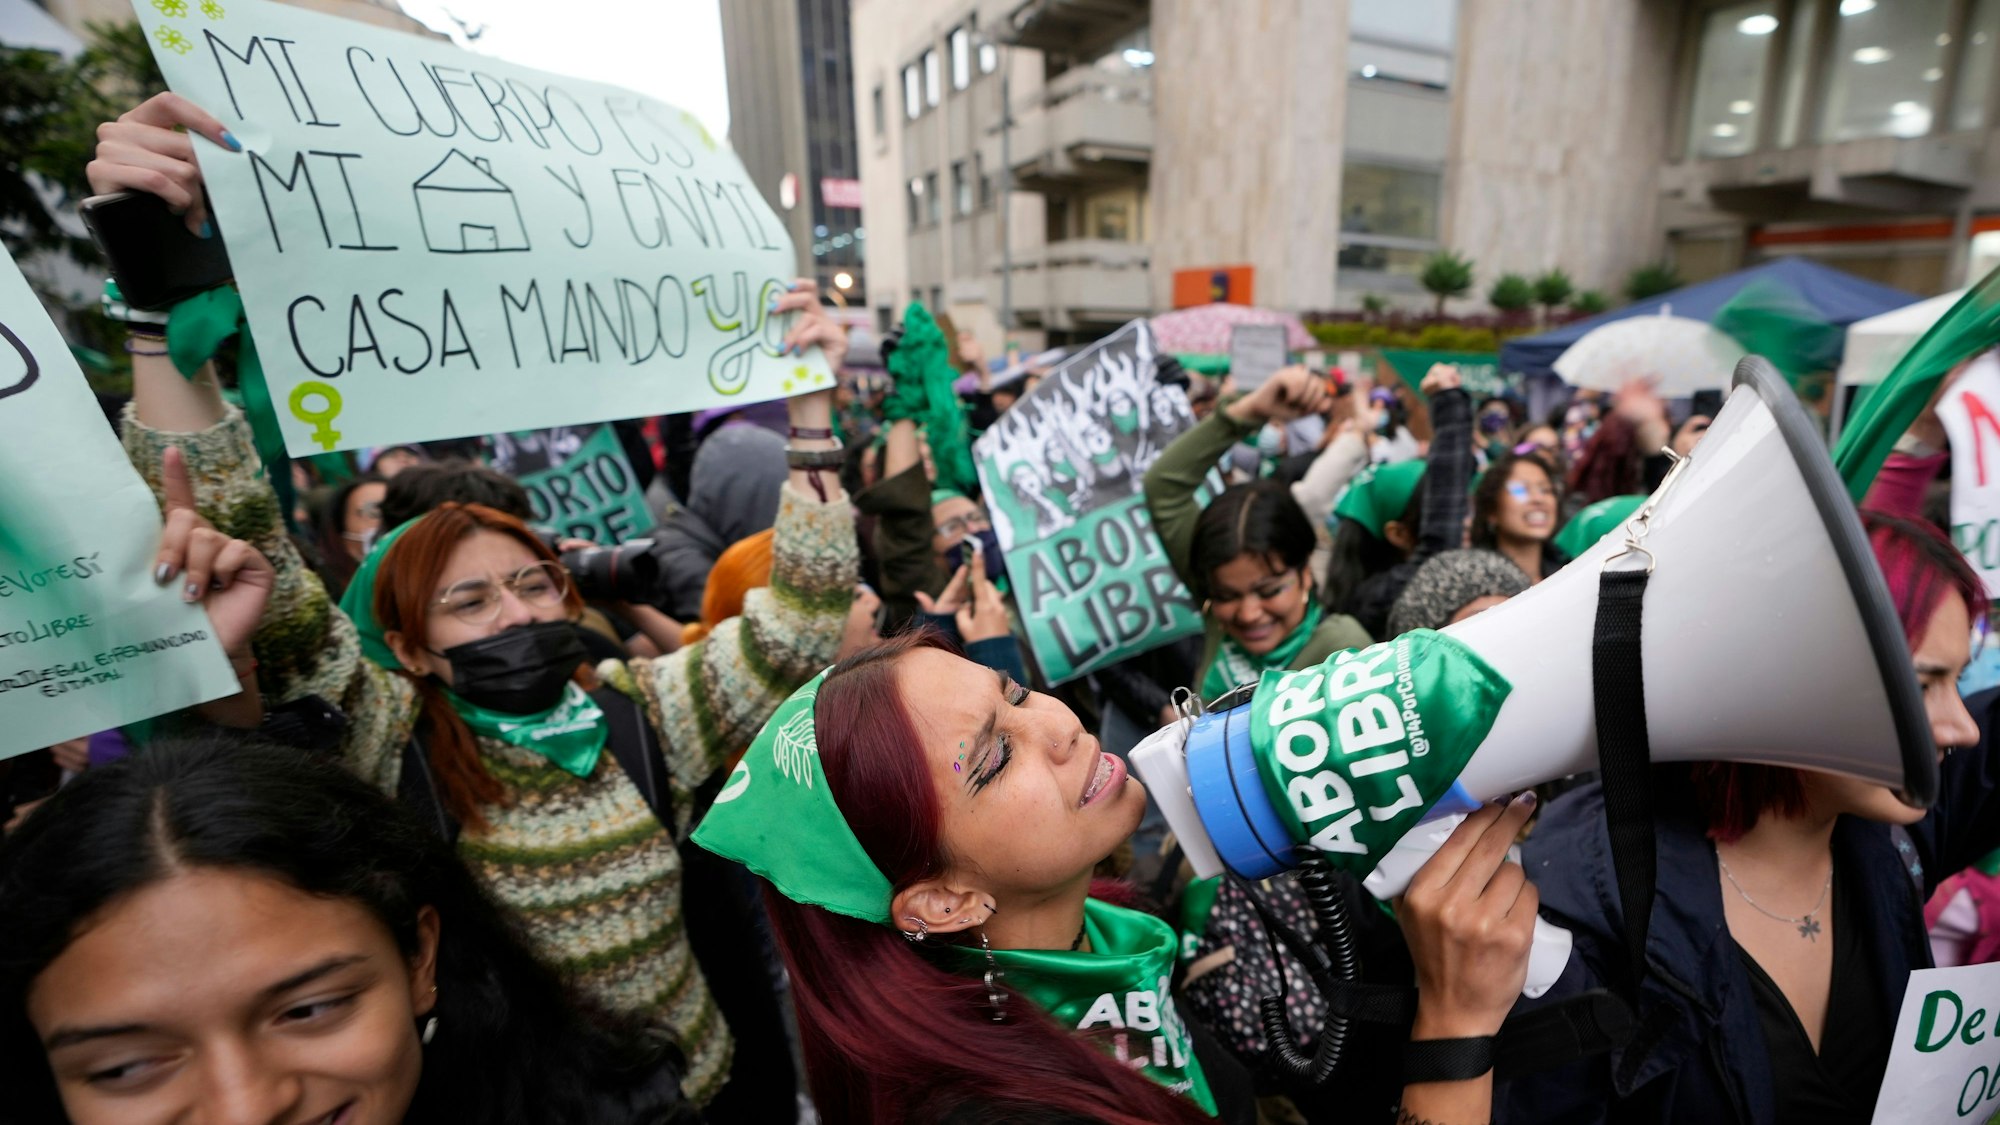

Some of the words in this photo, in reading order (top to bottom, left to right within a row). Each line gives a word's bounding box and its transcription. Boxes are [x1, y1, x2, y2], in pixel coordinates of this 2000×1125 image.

[202, 28, 341, 128] MI
[346, 45, 602, 156] CUERPO
[604, 96, 694, 169] ES
[247, 149, 399, 253] MI
[287, 287, 481, 378] CASA
[500, 275, 689, 368] MANDO
[27, 614, 94, 642] LIBRE
